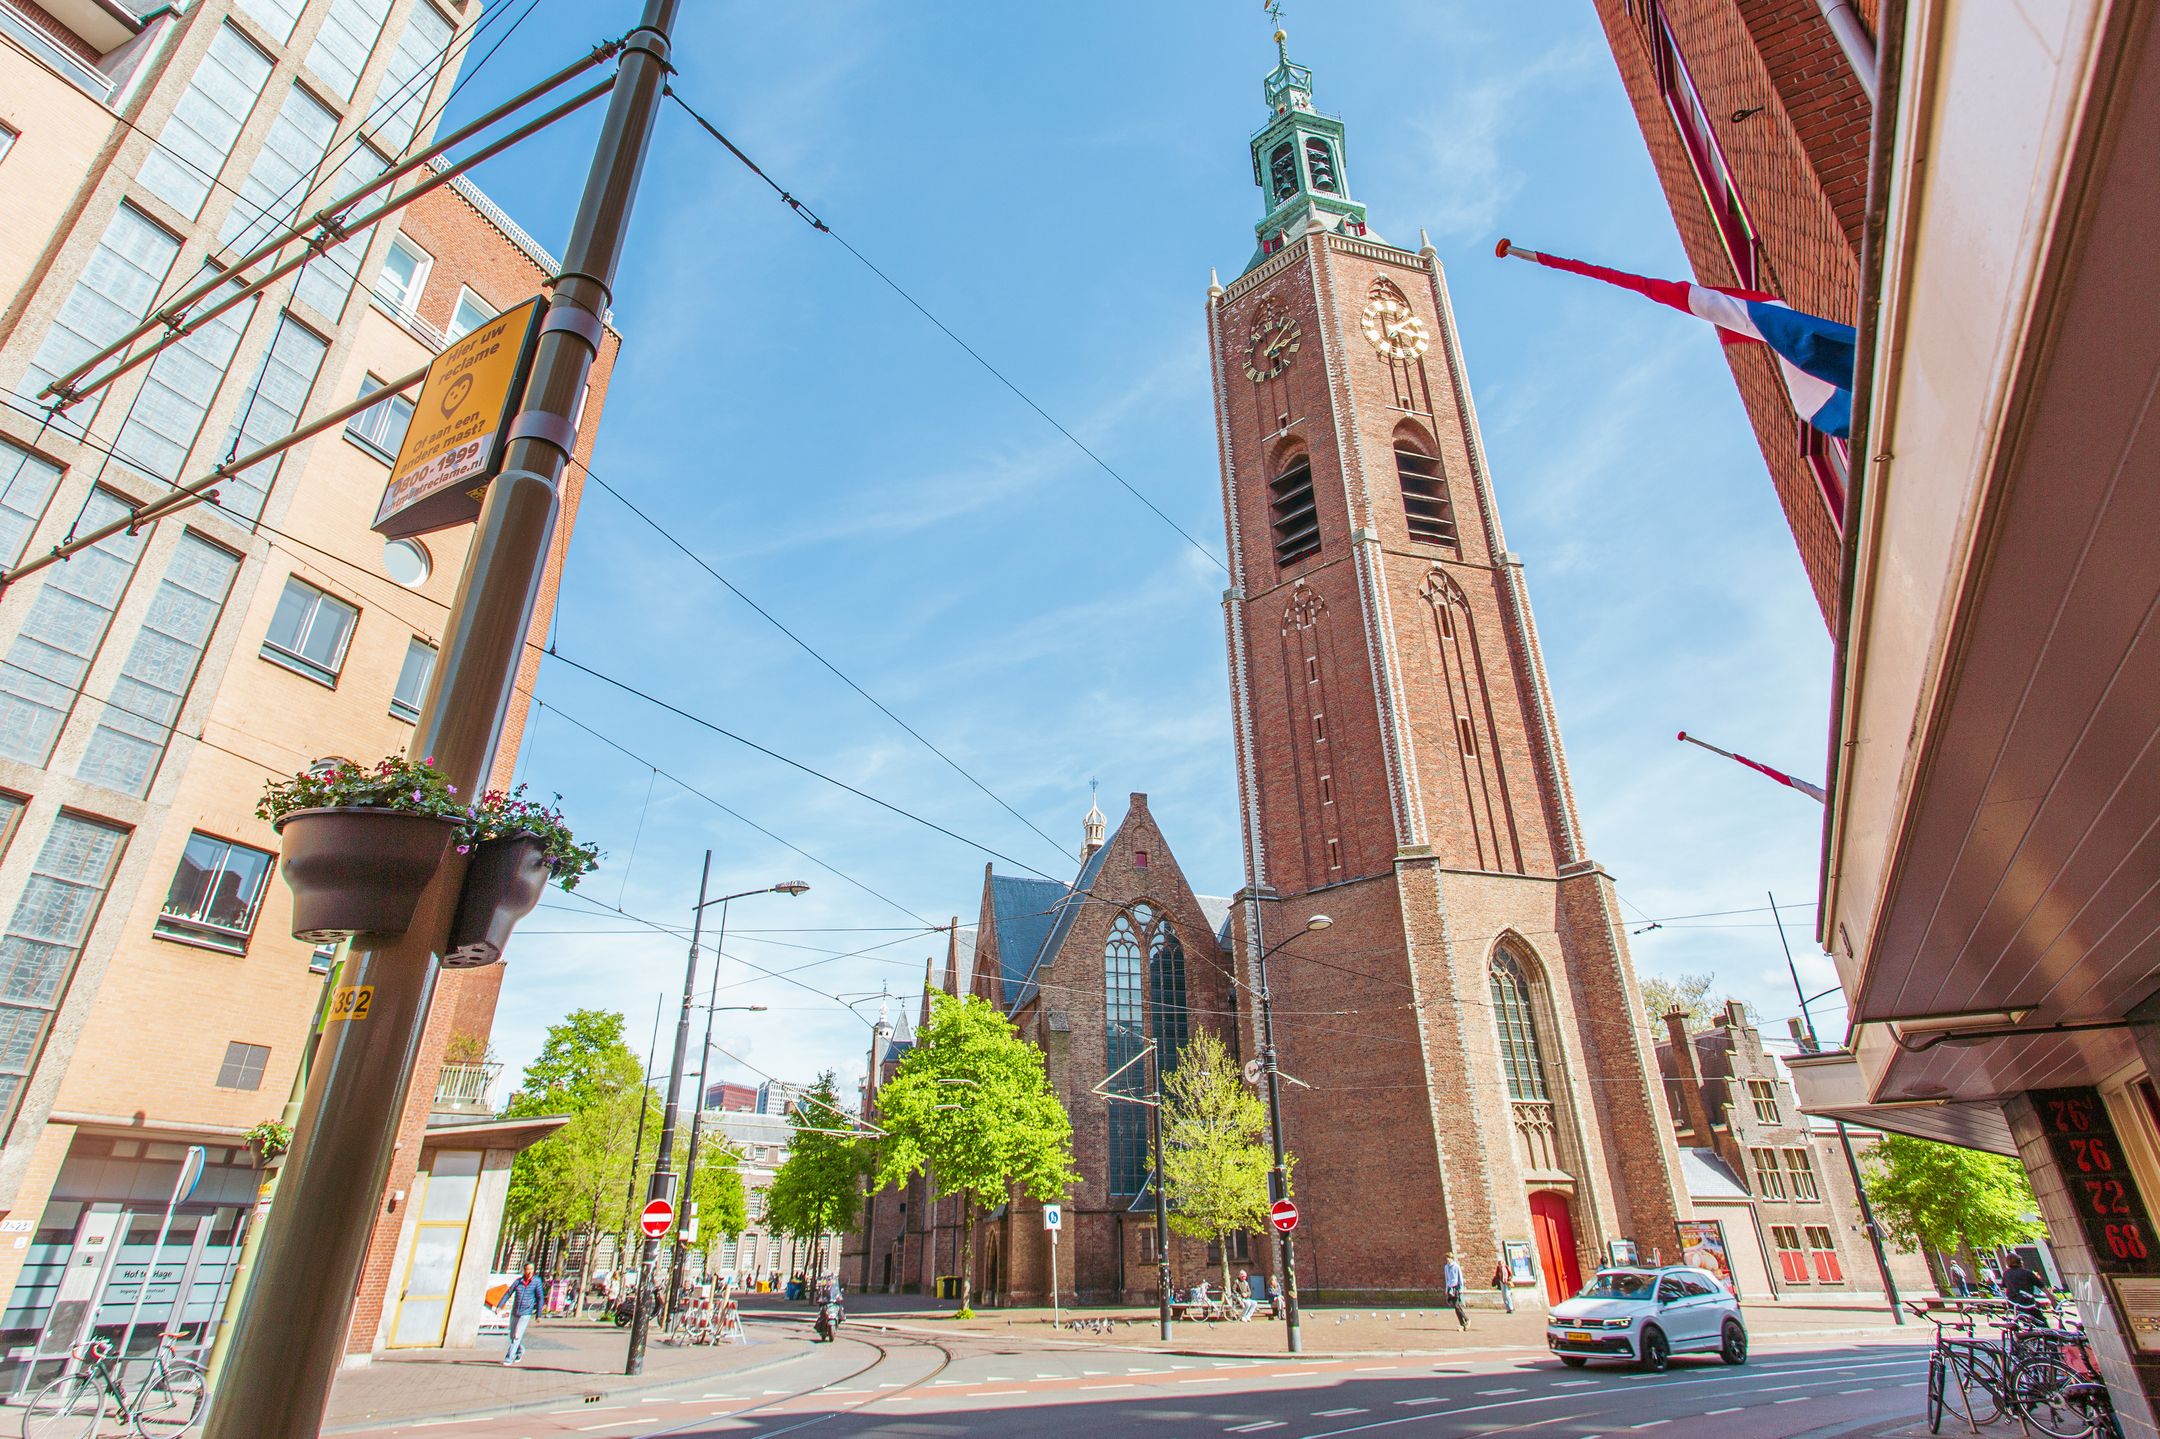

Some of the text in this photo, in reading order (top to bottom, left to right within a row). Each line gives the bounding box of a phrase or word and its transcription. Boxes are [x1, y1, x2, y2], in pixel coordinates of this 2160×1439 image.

[446, 323, 507, 366] Hier uw
[438, 343, 500, 385] reclame
[400, 419, 486, 473] andere mast?
[413, 411, 480, 453] Of aan een
[2069, 1138, 2111, 1172] 76
[2085, 1180, 2130, 1215] 72
[2105, 1224, 2148, 1259] 68
[124, 1270, 139, 1278] Hof
[153, 1270, 172, 1280] Hage
